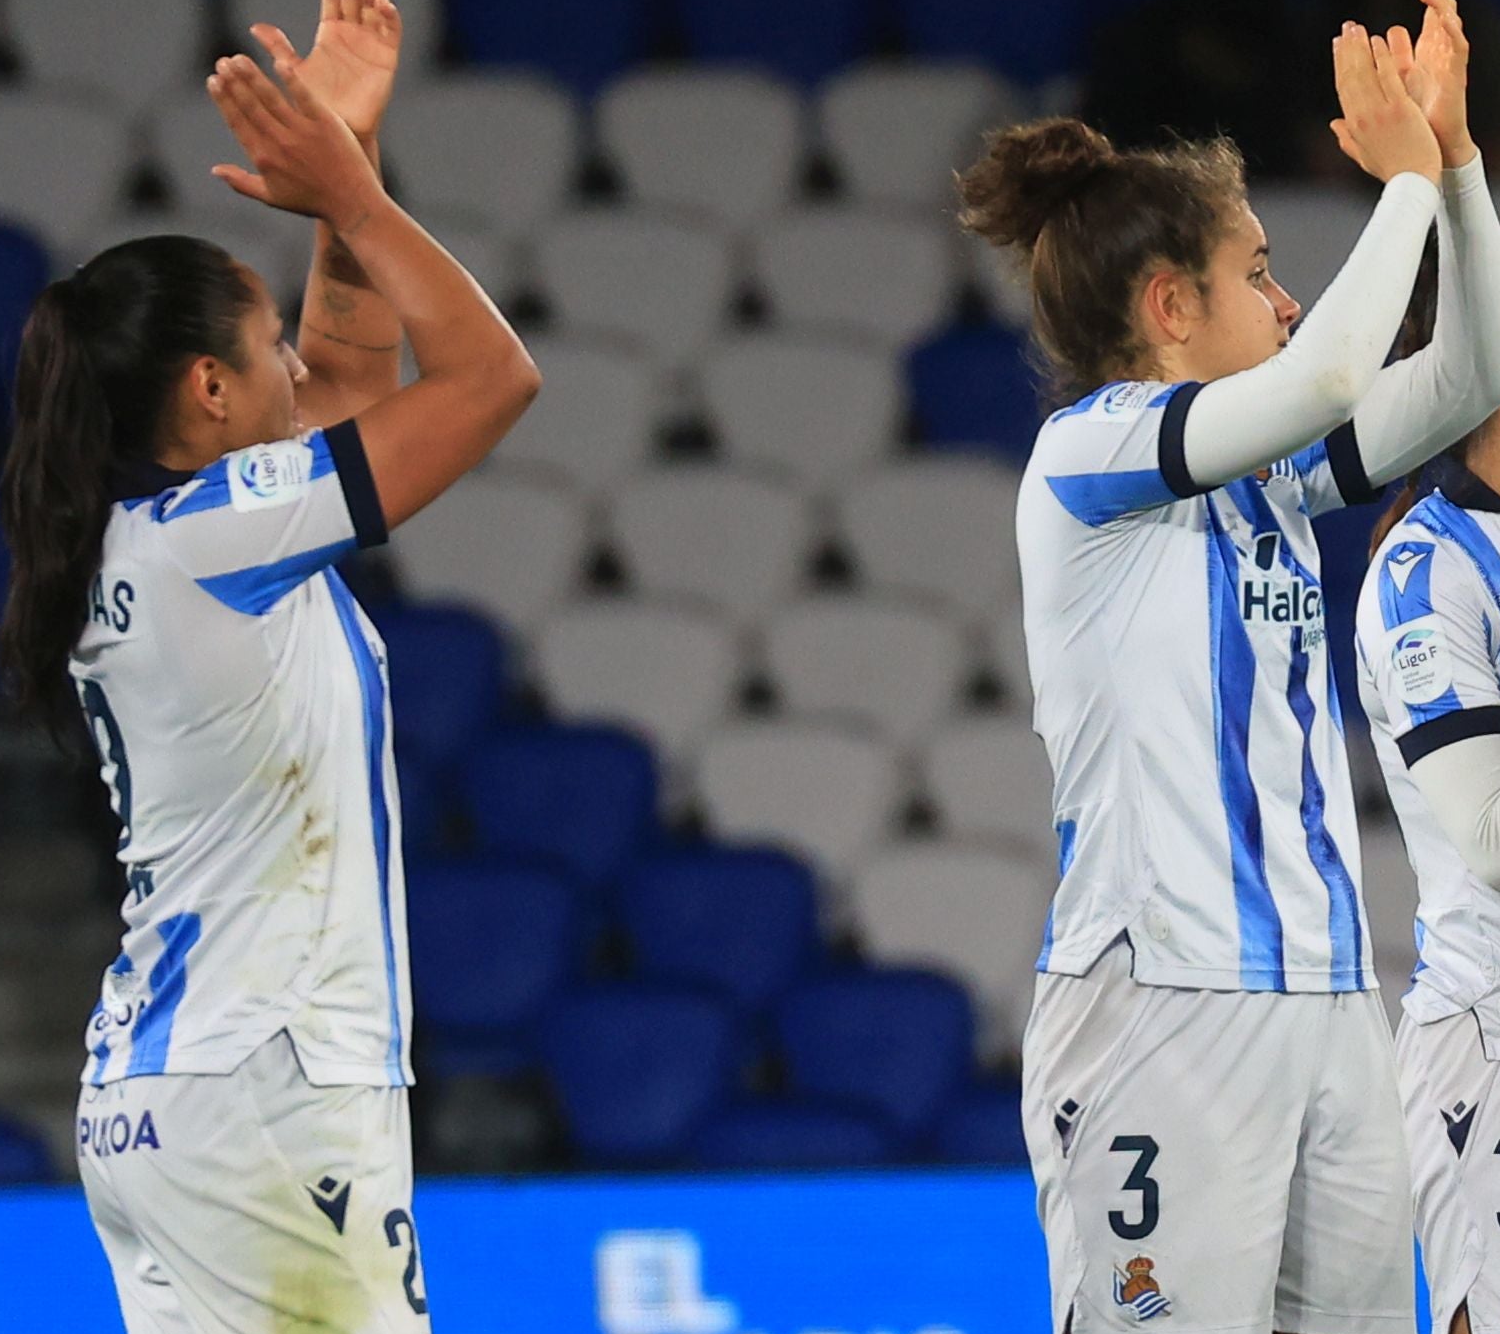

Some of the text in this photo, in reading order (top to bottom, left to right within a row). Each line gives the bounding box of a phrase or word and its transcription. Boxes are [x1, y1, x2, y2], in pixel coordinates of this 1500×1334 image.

[1398, 645, 1437, 670] Liga F
[1107, 1134, 1160, 1241] 3
